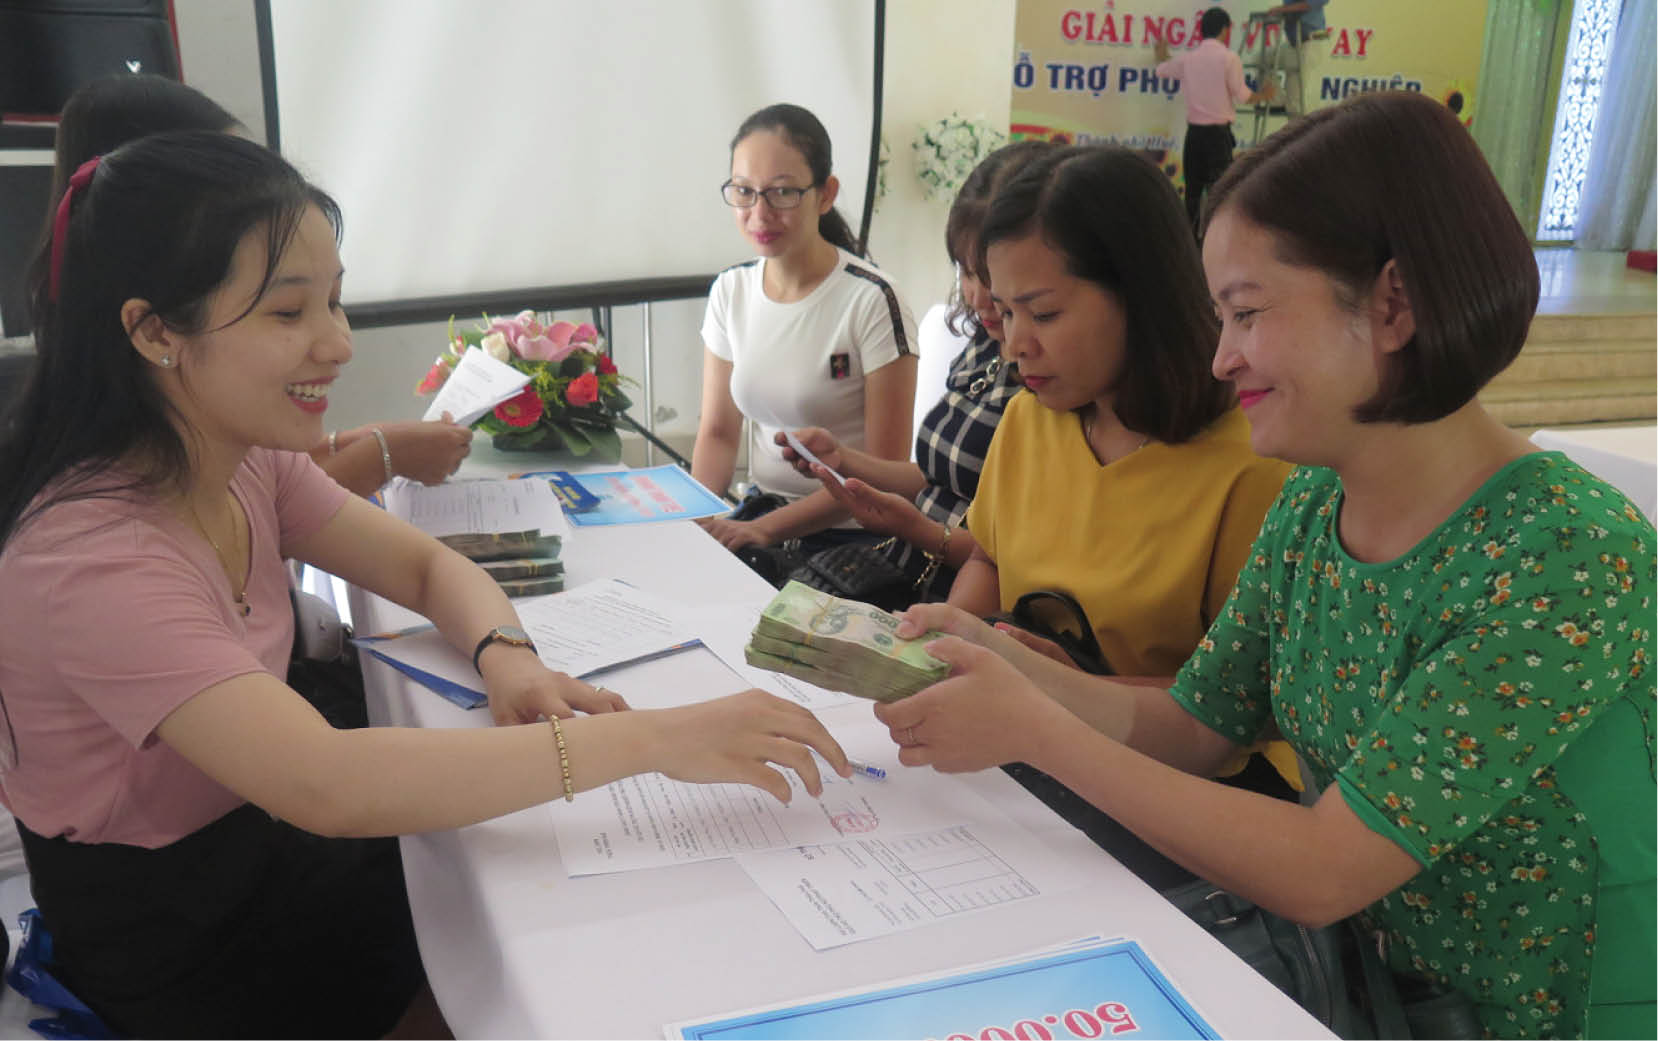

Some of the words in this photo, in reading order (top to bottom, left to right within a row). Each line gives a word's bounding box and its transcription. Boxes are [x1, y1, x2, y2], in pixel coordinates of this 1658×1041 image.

[1061, 0, 1134, 44] GIẢI
[1142, 9, 1232, 49] NGÂ
[1325, 26, 1374, 56] AY
[1013, 52, 1035, 88] Ỗ
[1046, 63, 1109, 97] TRỢ
